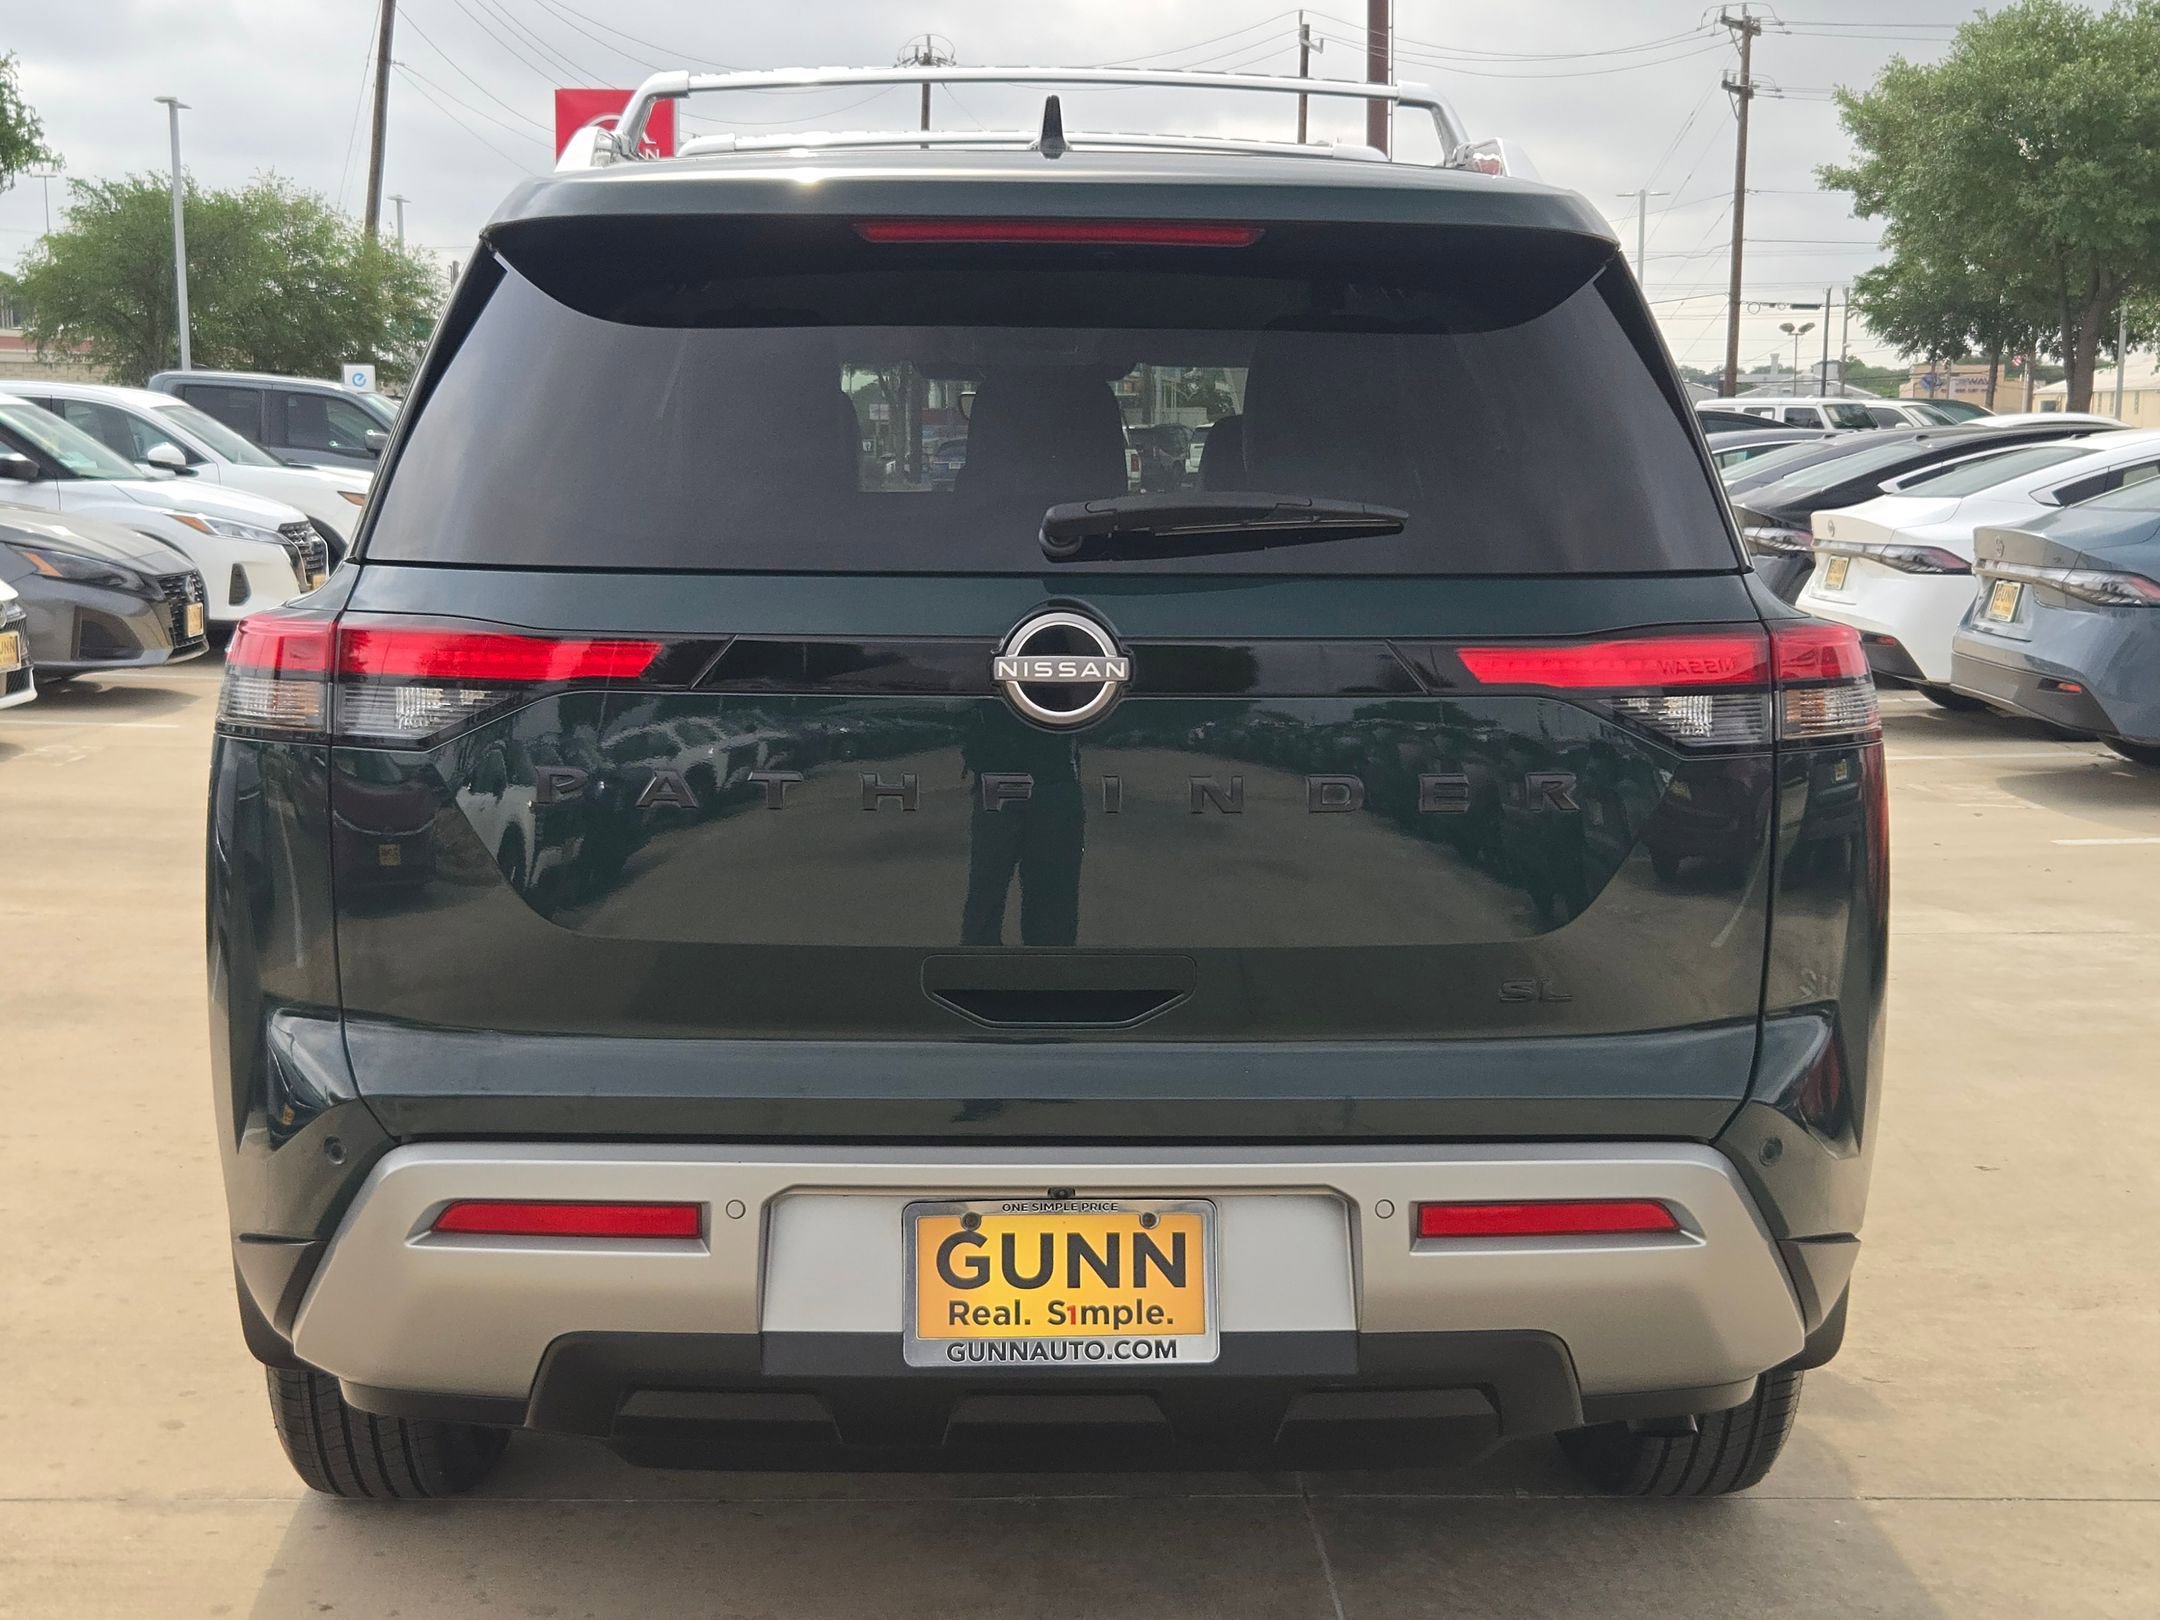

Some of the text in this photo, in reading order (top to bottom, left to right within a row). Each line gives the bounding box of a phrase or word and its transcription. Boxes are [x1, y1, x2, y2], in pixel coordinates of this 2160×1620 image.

[998, 661, 1125, 677] NISSAN
[534, 766, 1580, 814] PATHFINDER
[1500, 979, 1574, 1002] SL
[1001, 1202, 1119, 1212] ONE SIMPLE PRICE
[936, 1231, 1187, 1290] GUNN
[949, 1299, 1031, 1326] Real.
[945, 1339, 1177, 1362] GUNNAUTO.COM
